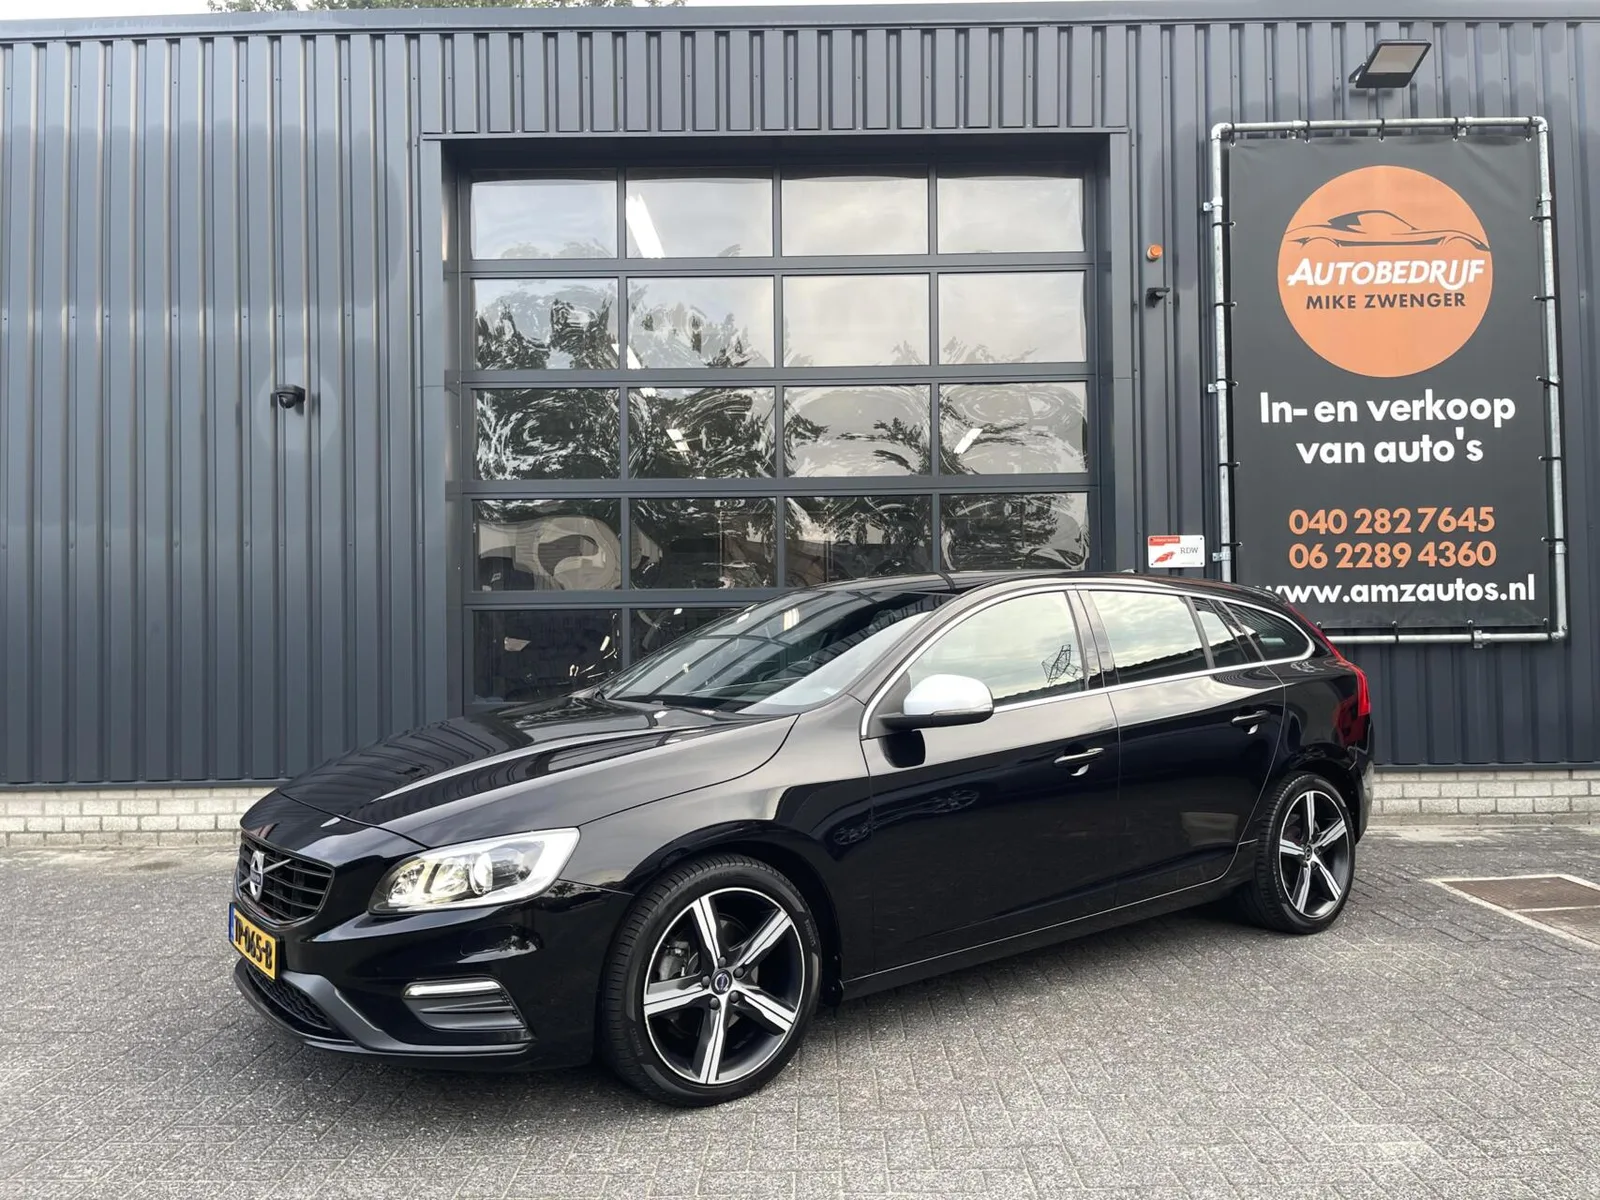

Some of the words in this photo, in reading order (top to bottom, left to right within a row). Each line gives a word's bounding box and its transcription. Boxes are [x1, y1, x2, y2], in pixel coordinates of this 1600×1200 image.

[1287, 258, 1485, 291] AUTOBEDRIJF
[1306, 294, 1357, 310] MIKE
[1364, 292, 1467, 309] ZWENGER
[1313, 400, 1358, 423] en
[1366, 388, 1516, 428] verkoop
[1295, 441, 1366, 464] van
[1373, 426, 1484, 464] auto's
[1288, 508, 1348, 536] 040
[1353, 506, 1411, 535] 282
[1417, 505, 1495, 533] 7645
[1179, 546, 1199, 555] RDW
[1288, 543, 1329, 570] 06
[1334, 541, 1412, 569] 2289
[1417, 540, 1497, 568] 4360
[1255, 573, 1536, 604] ww.amzautos.nl
